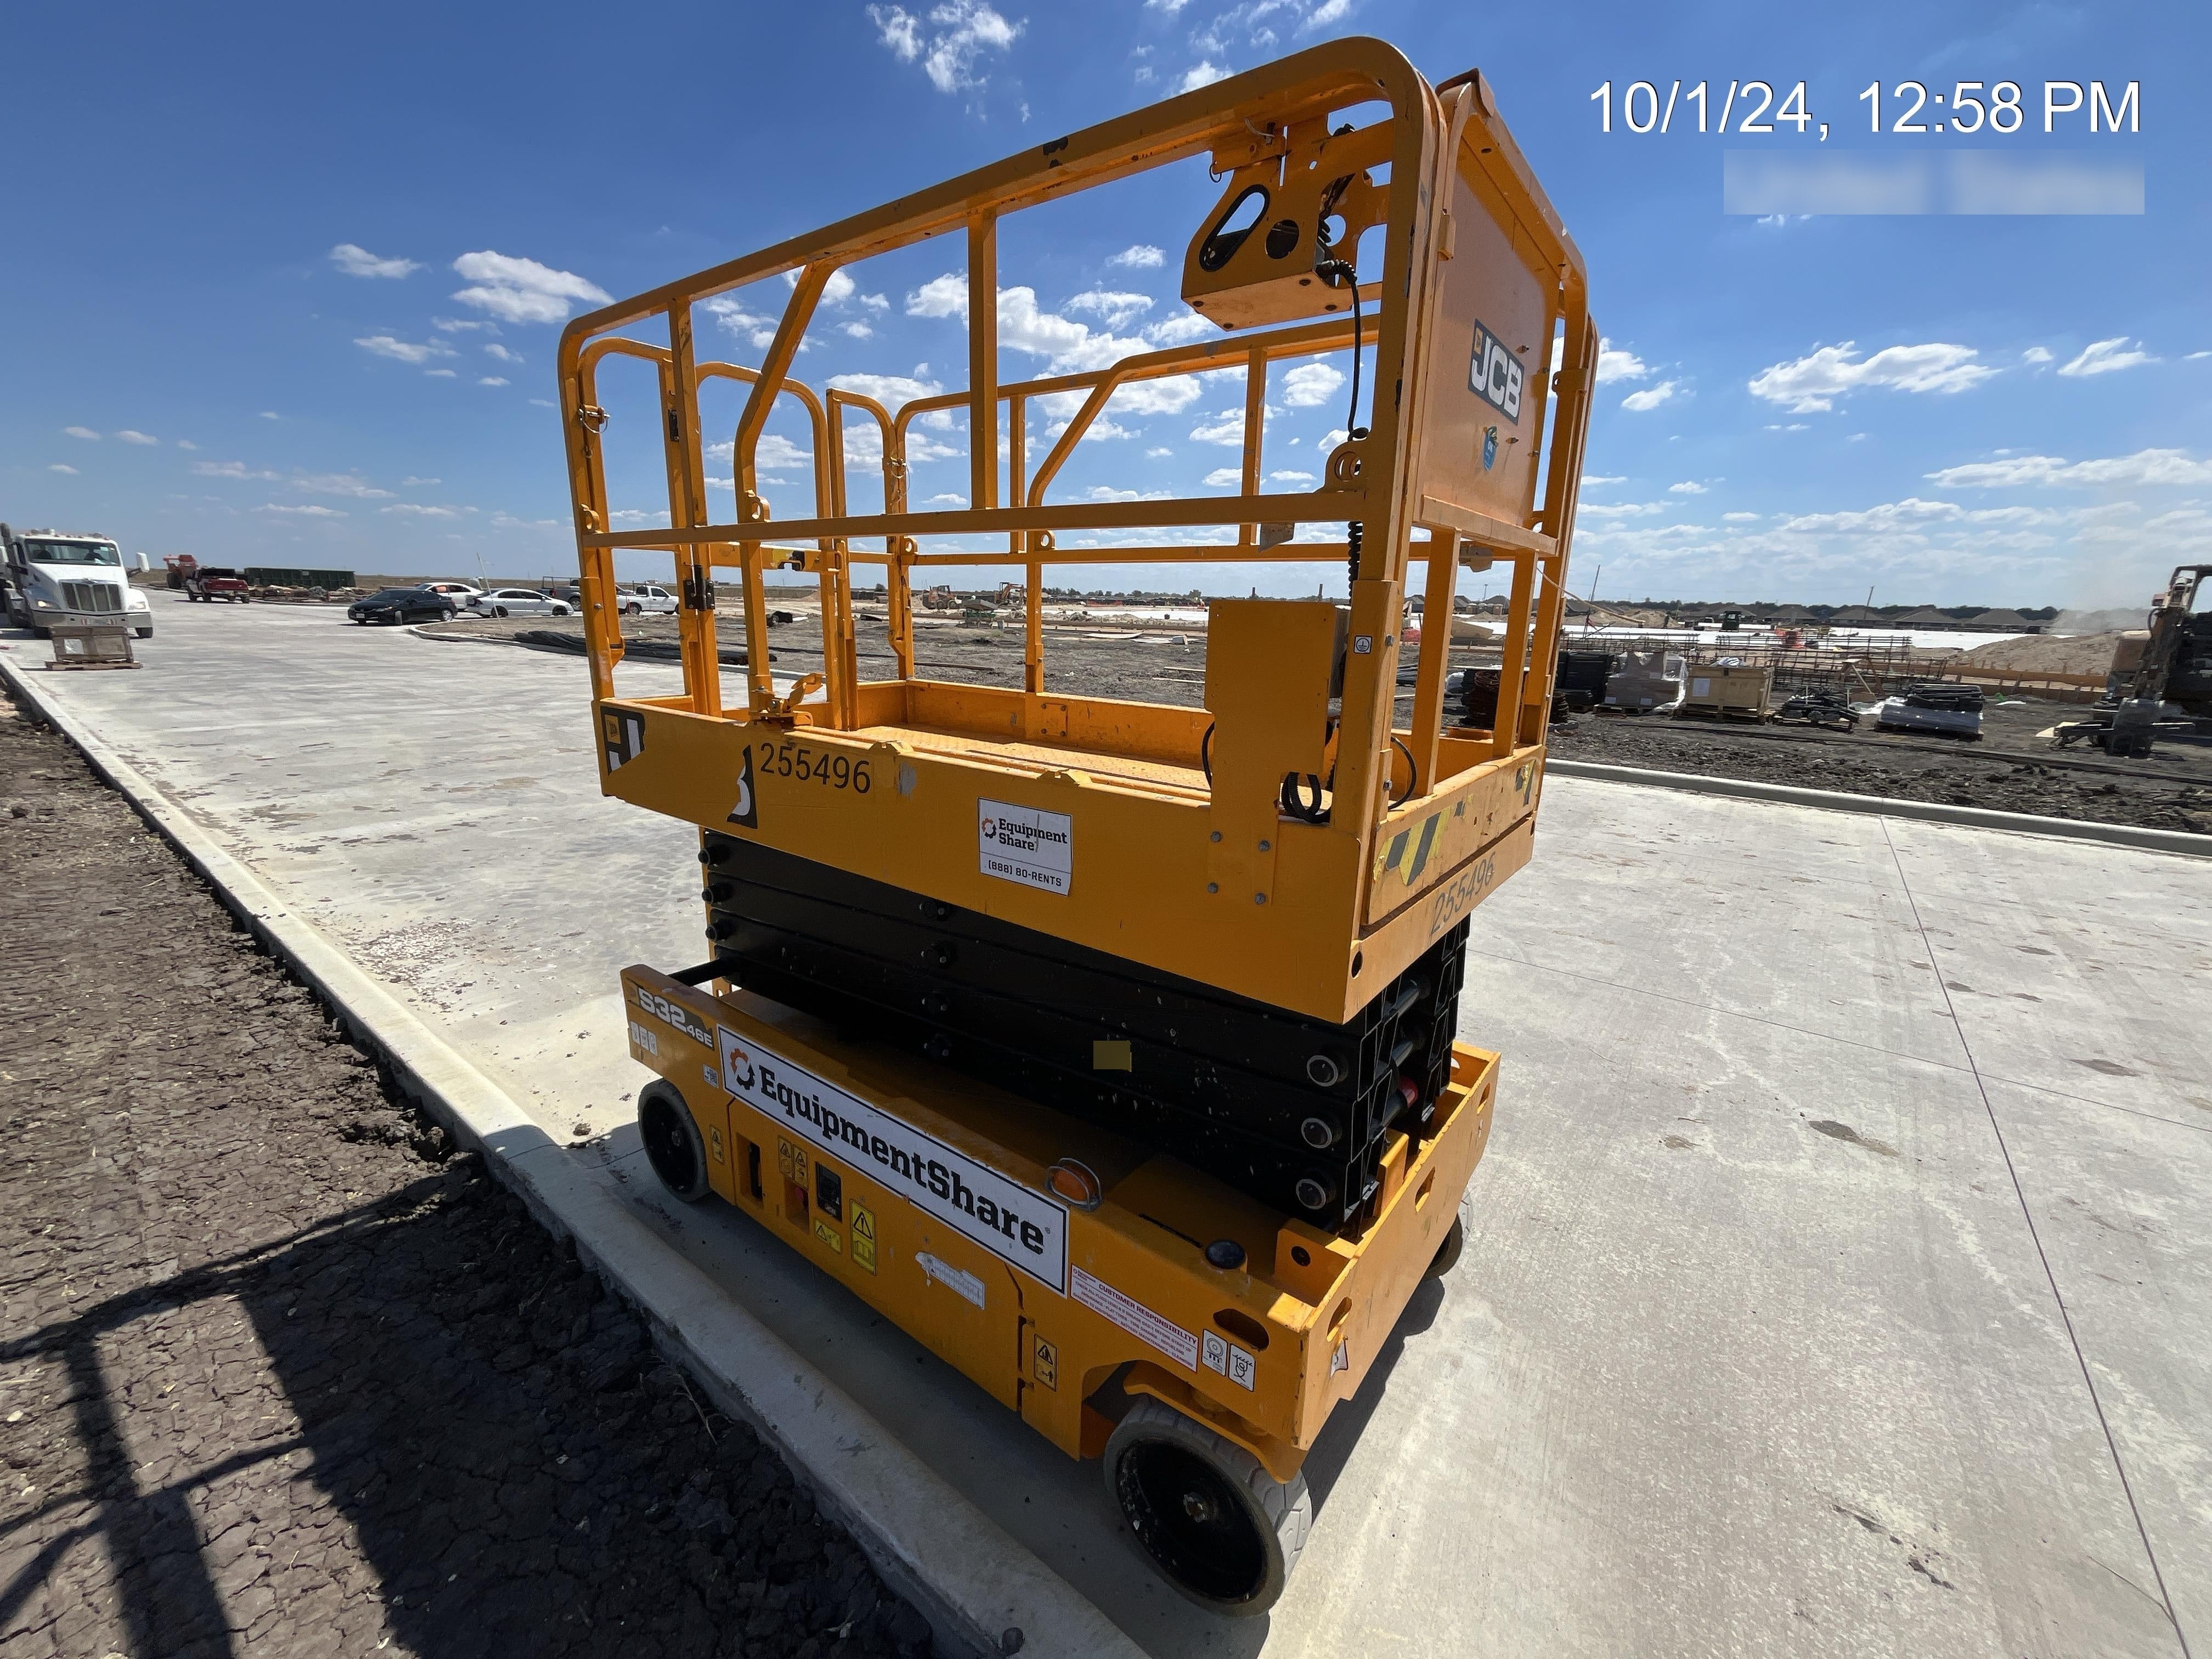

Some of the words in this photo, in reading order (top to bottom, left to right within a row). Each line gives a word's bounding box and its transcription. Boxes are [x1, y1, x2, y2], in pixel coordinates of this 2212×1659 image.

[1471, 336, 1522, 417] JCB
[760, 742, 871, 794] 255496
[998, 817, 1068, 844] Equipment
[998, 832, 1035, 851] Share
[988, 860, 1013, 875] (888)
[1015, 867, 1062, 887] 80-RENTS
[1431, 851, 1496, 935] 255496
[1098, 1284, 1135, 1310] CUSTOMER
[1136, 1305, 1197, 1345] RESPONSIBILITY
